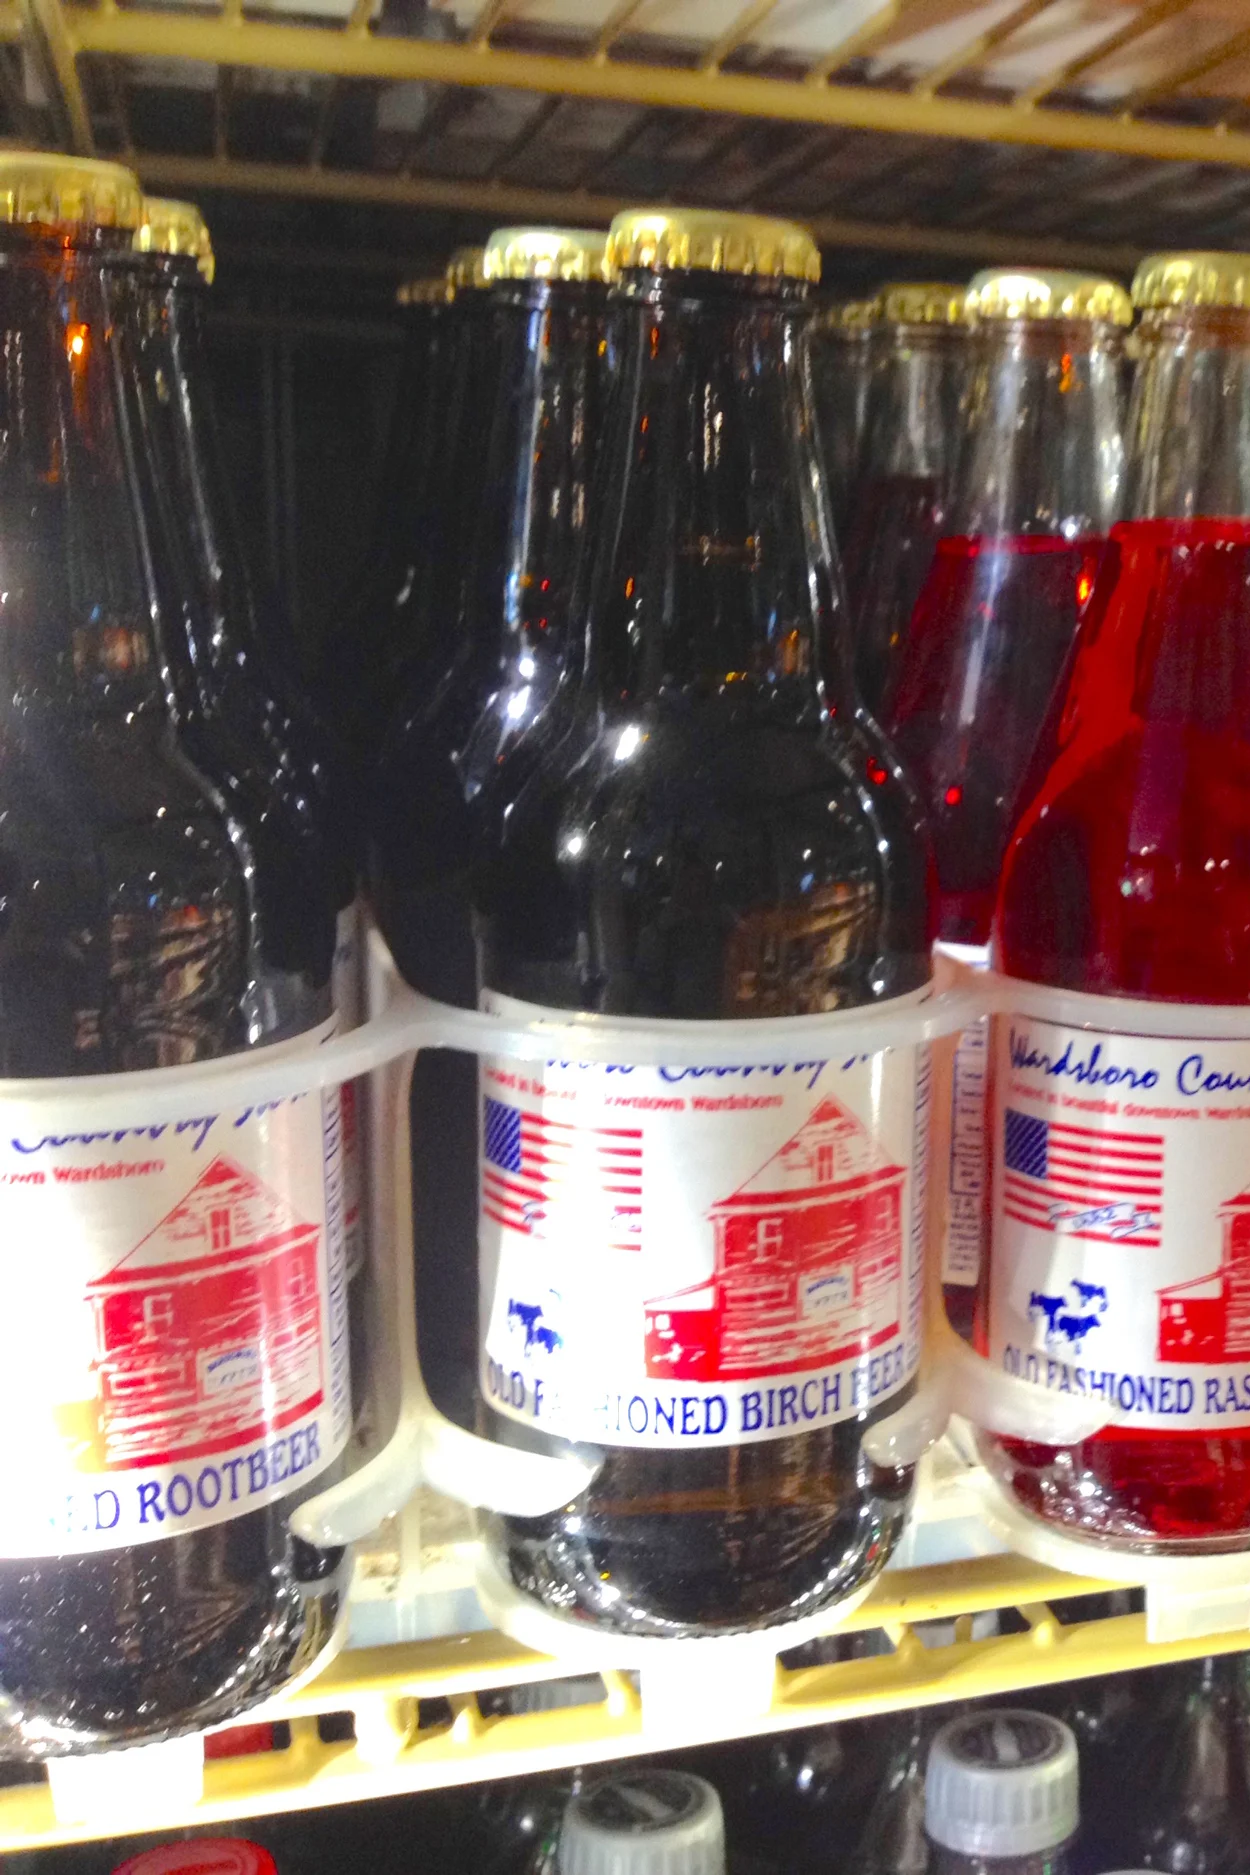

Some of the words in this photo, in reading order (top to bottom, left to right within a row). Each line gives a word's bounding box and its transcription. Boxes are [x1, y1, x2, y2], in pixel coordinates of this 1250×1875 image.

[1009, 1028, 1160, 1090] Wardsboro
[741, 1371, 842, 1433] BIRCH
[136, 1420, 321, 1525] ROOTBEER
